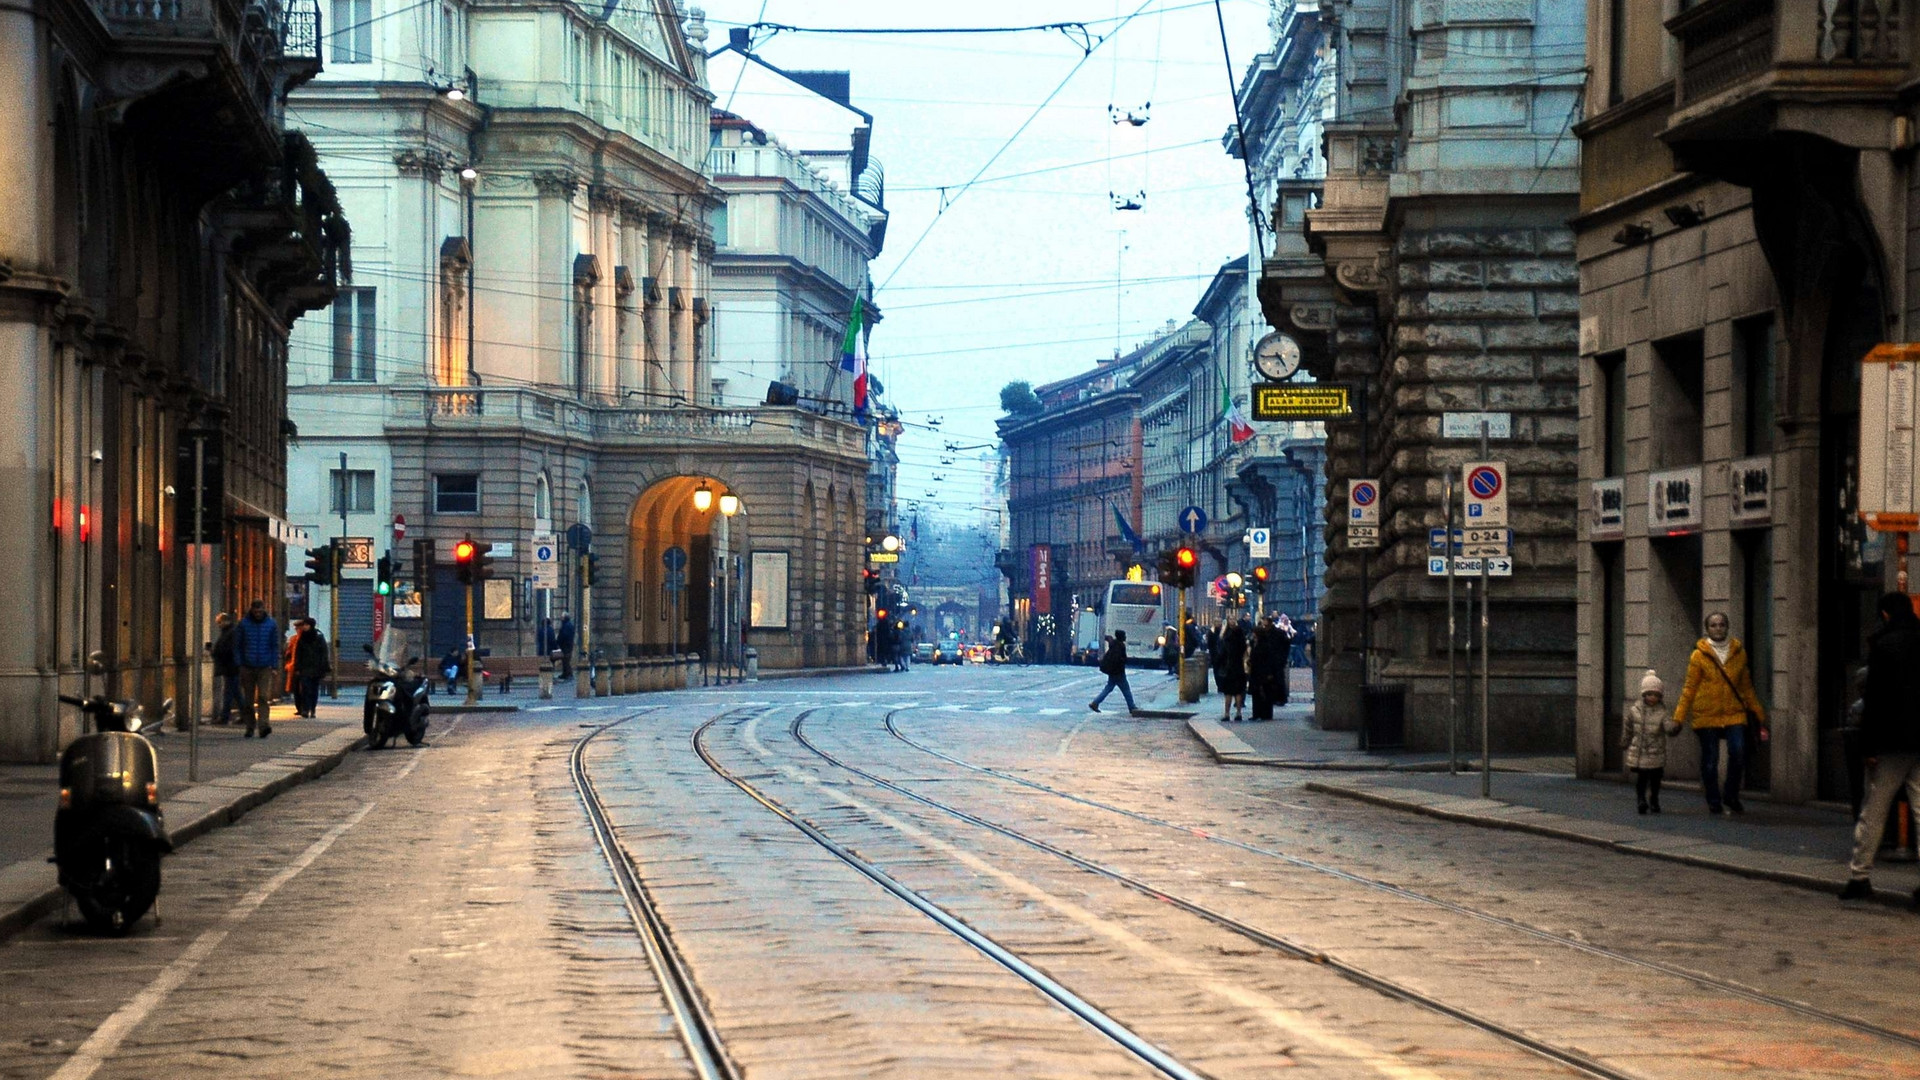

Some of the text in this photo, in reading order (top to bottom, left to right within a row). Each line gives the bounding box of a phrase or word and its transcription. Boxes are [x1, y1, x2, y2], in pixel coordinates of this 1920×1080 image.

[1353, 528, 1373, 537] 0-24
[1471, 531, 1499, 542] 0-24
[374, 609, 382, 632] SHOP
